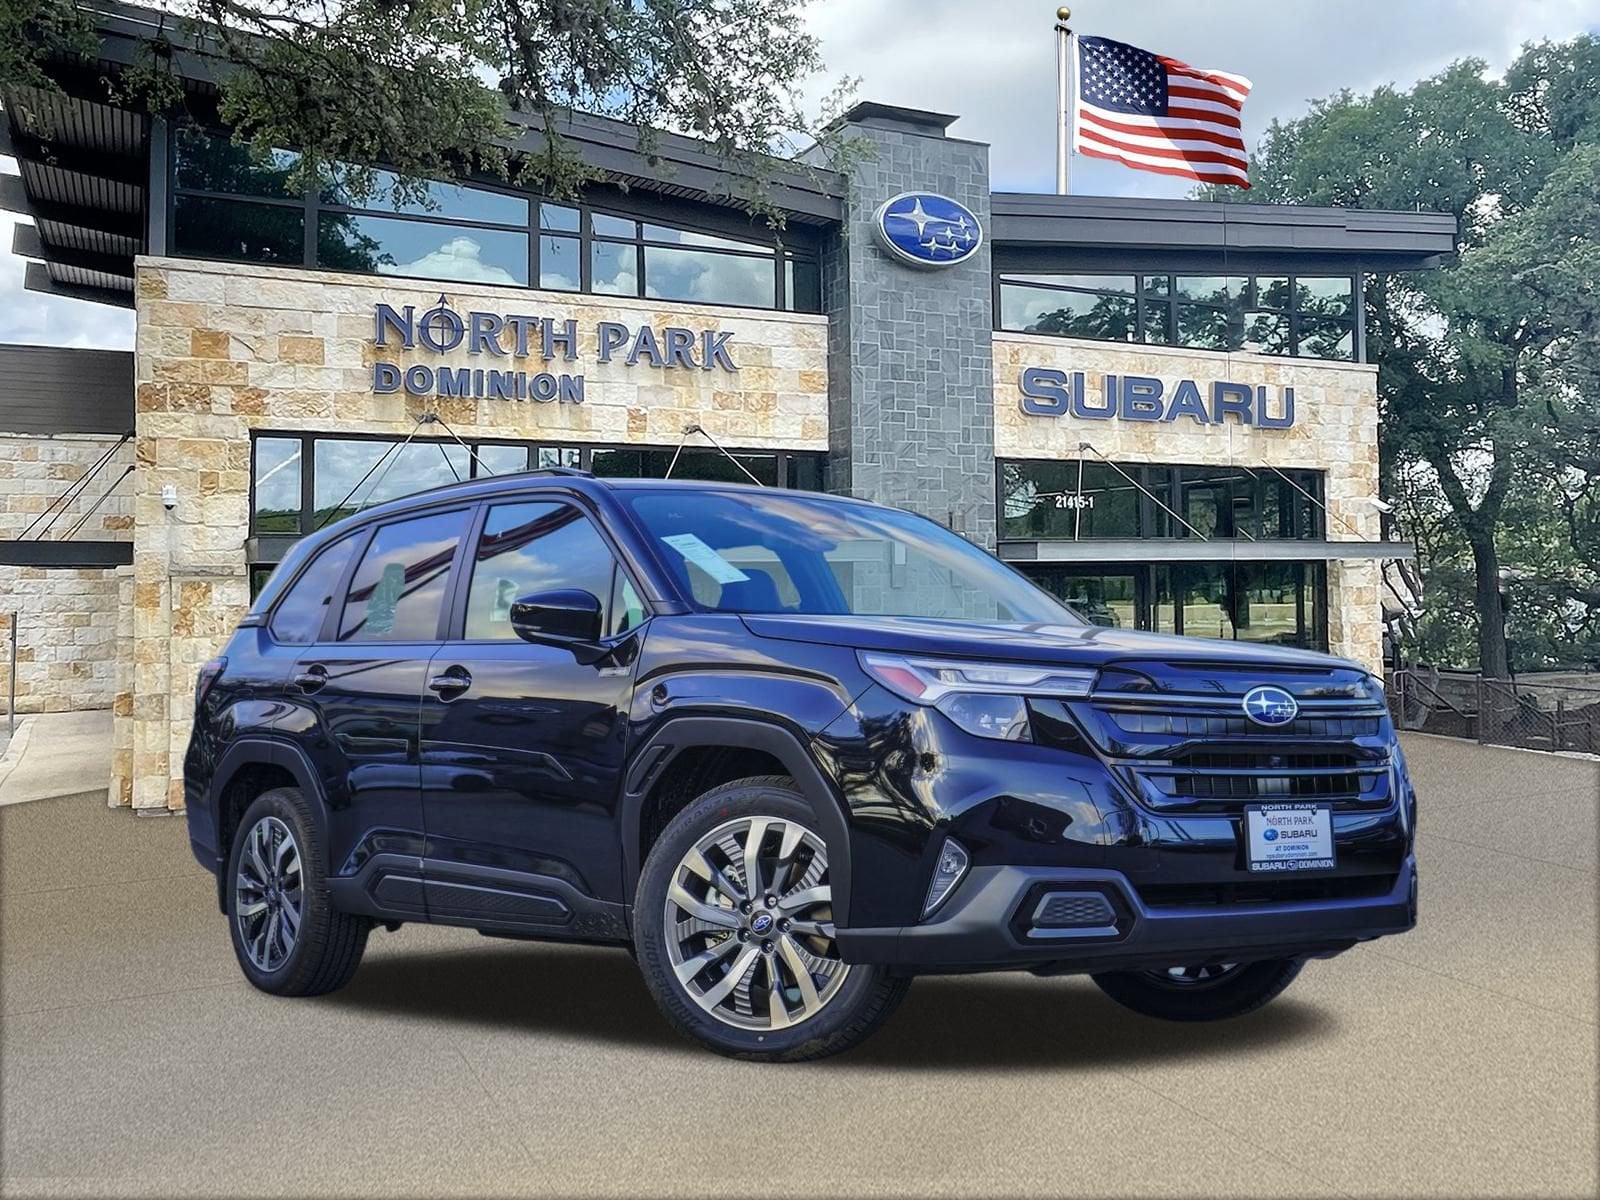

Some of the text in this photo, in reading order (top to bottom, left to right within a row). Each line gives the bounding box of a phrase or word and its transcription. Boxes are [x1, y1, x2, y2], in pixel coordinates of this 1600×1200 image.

[374, 301, 742, 373] NORTH PARK
[373, 361, 585, 404] DOMINION
[1019, 367, 1295, 430] SUBARU
[1055, 495, 1094, 509] 21415-1
[1266, 815, 1314, 826] NORTH PARK
[1280, 829, 1318, 839] SUBARU
[1252, 859, 1334, 871] SUBARU DOMINION
